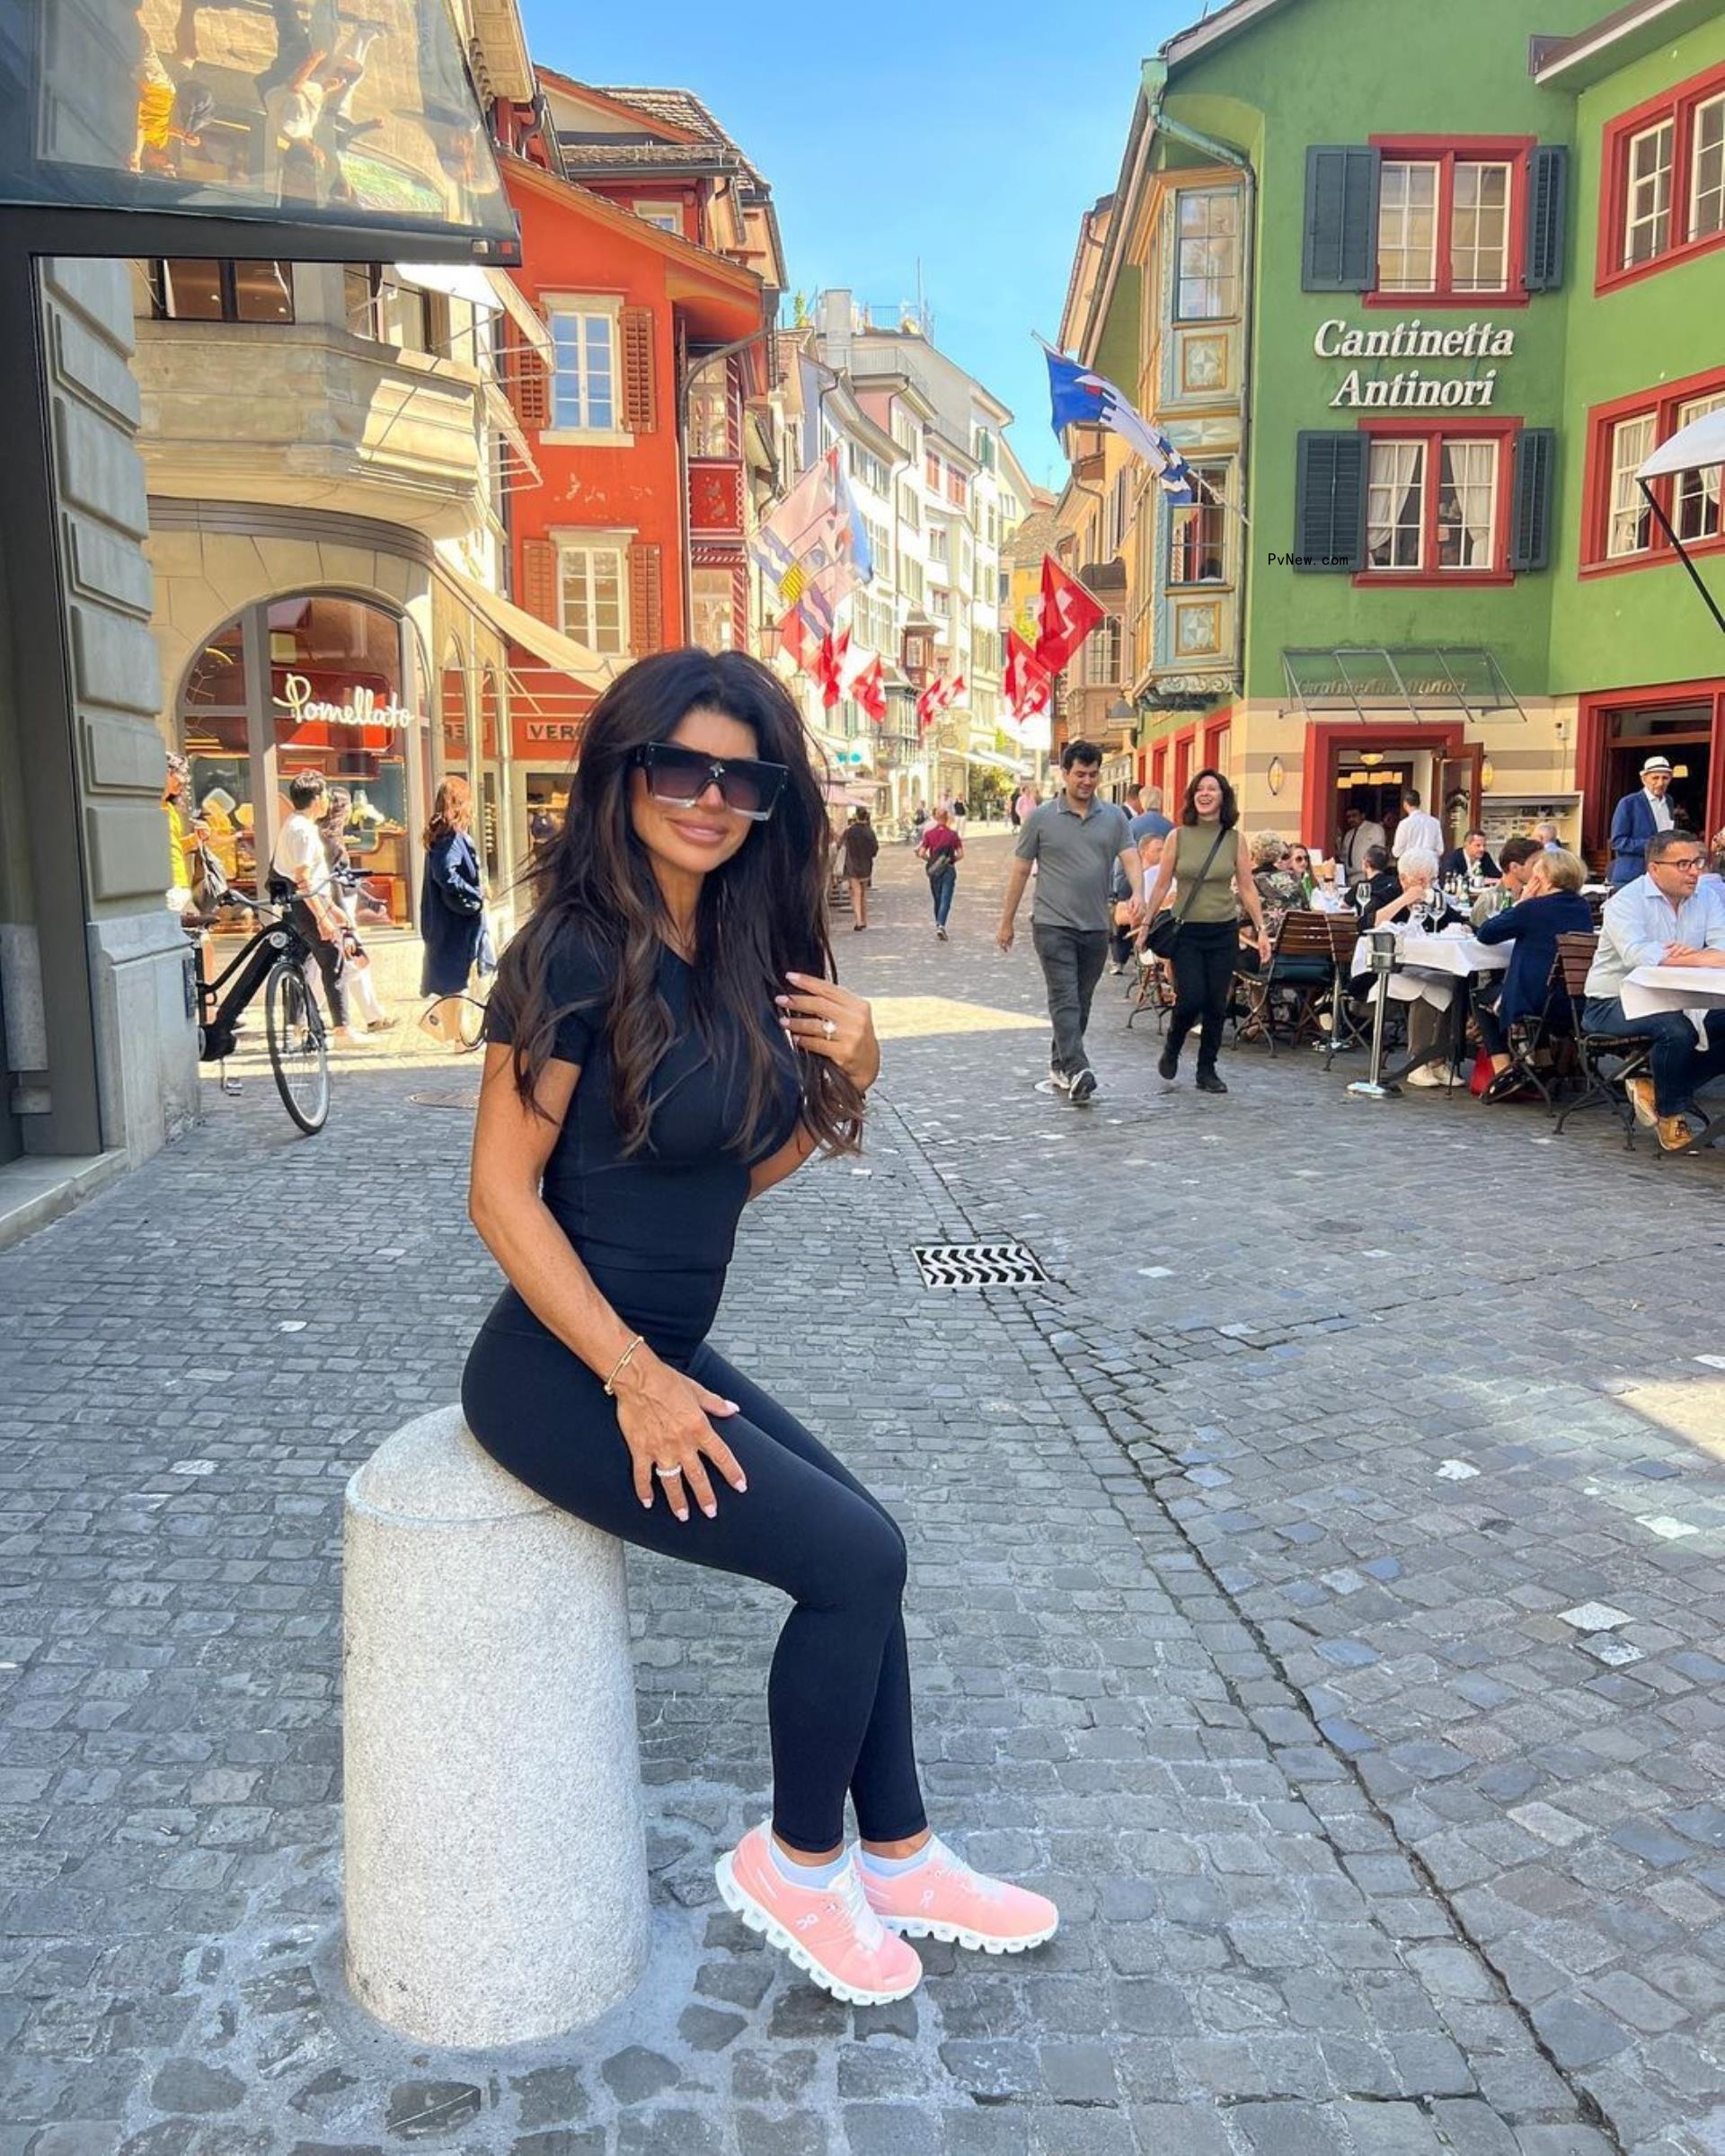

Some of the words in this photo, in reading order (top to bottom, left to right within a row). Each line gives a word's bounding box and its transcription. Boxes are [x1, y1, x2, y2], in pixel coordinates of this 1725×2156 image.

[1314, 319, 1515, 358] Cantinetta
[1328, 369, 1497, 407] Antinori
[272, 674, 415, 729] Pomellato
[529, 724, 581, 739] VER
